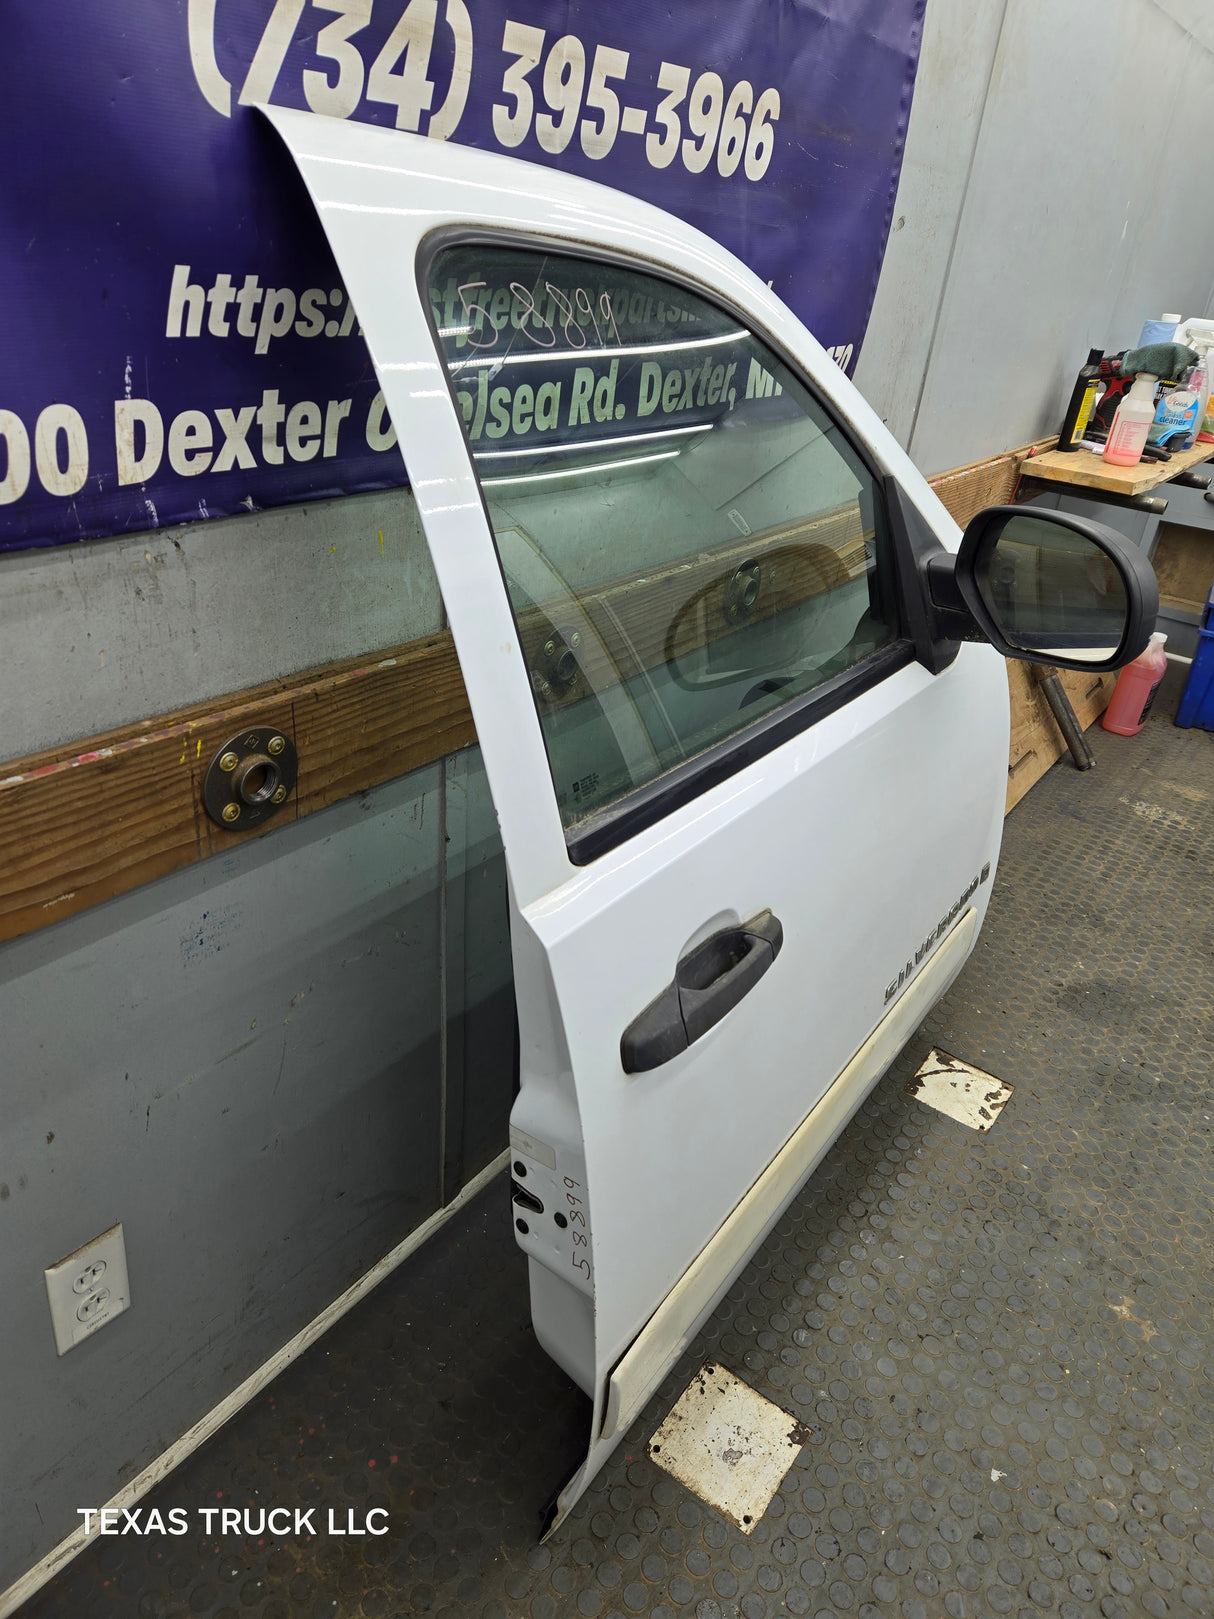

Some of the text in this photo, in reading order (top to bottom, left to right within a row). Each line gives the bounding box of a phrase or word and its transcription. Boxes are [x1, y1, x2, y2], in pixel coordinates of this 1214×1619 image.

[188, 0, 781, 182] (734) 395-3966
[457, 281, 622, 349] 58899
[114, 389, 352, 487] Dexter
[567, 358, 626, 427] Rd.
[637, 356, 738, 418] Dexter,
[1159, 416, 1187, 426] cleaner
[563, 1175, 591, 1281] 58899
